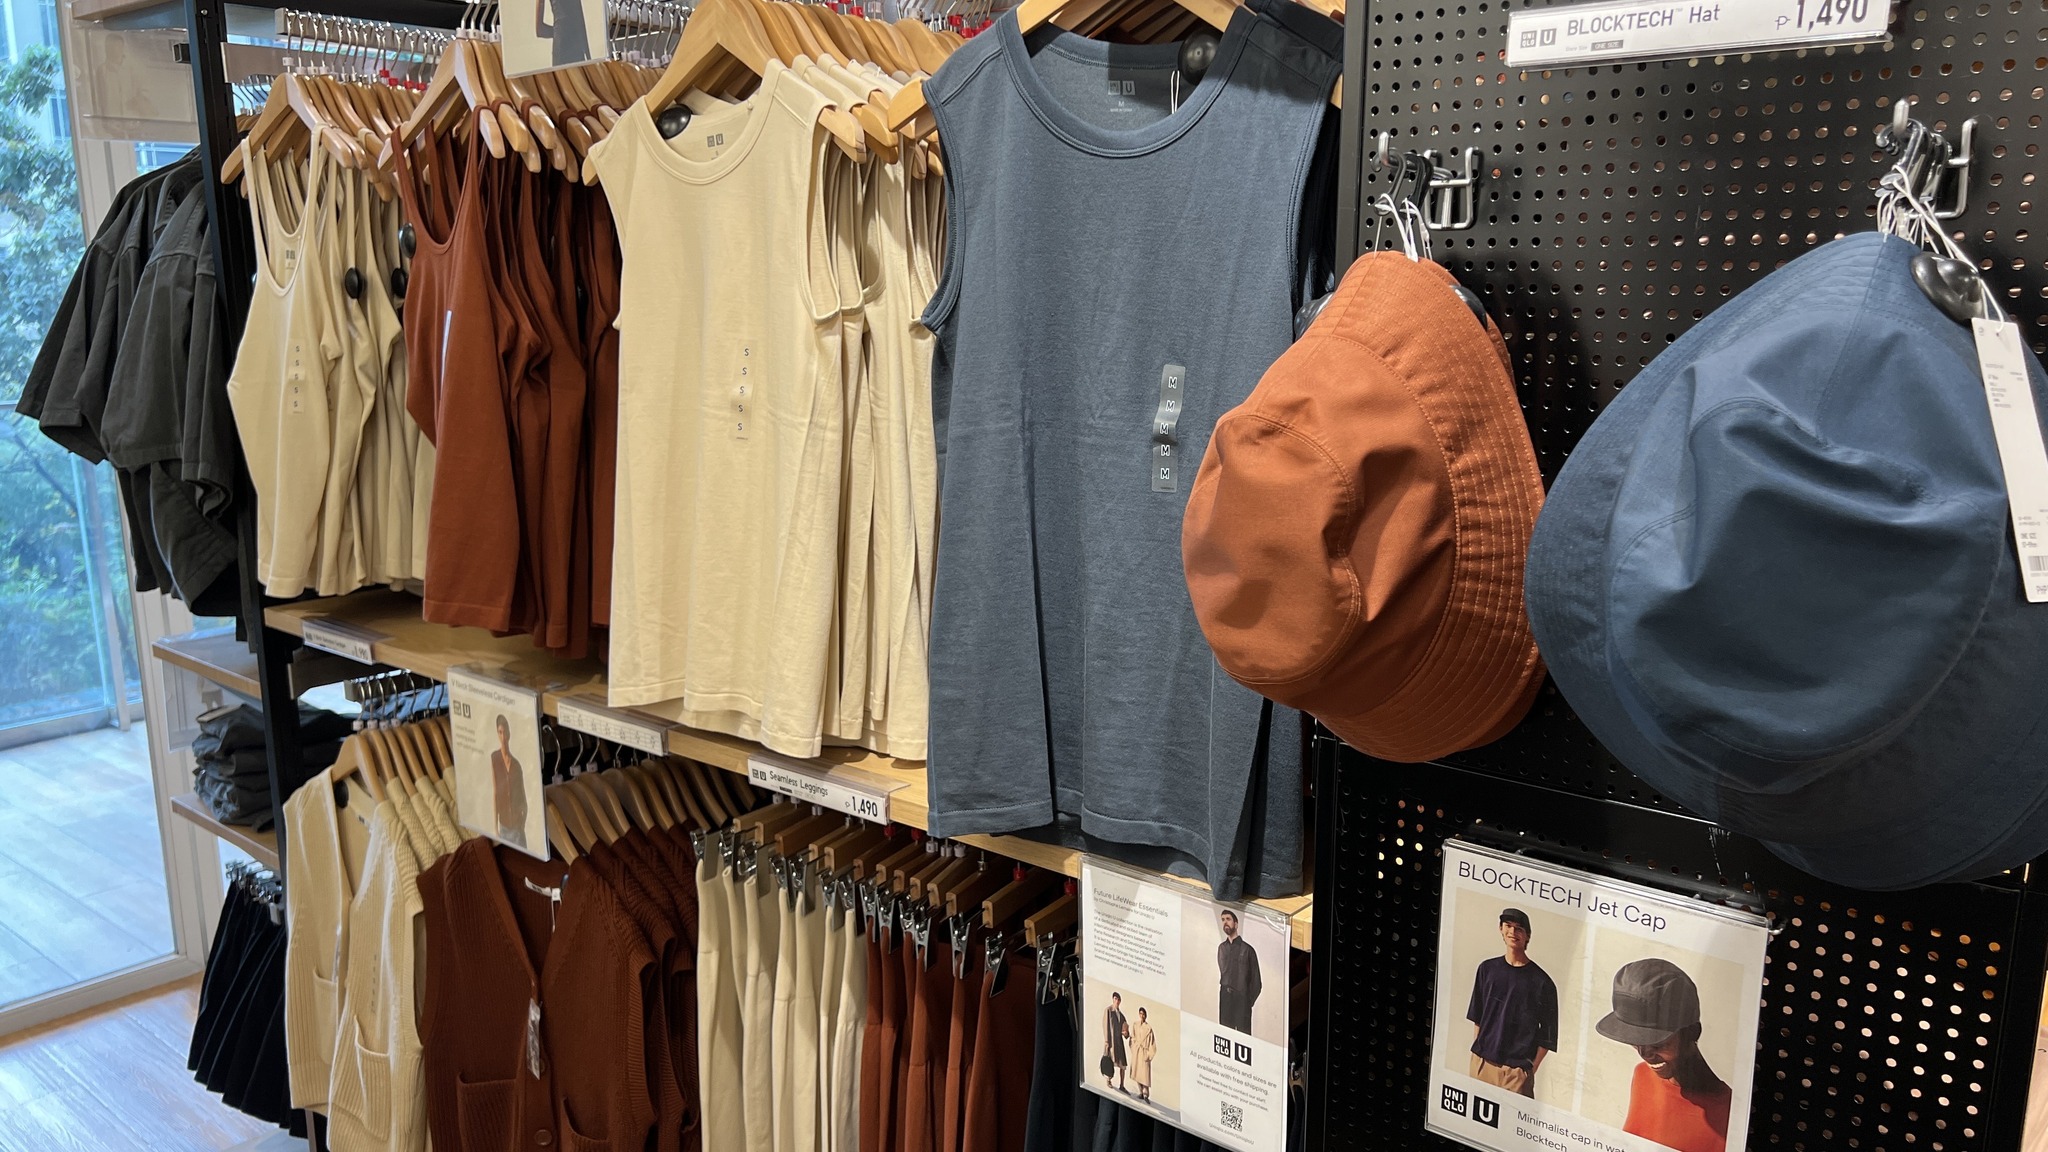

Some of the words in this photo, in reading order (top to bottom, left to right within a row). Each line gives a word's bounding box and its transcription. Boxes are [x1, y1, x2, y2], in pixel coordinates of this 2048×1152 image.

[1689, 4, 1720, 24] Hat
[1542, 30, 1553, 44] U
[744, 348, 749, 356] S
[742, 367, 747, 375] S
[1168, 376, 1177, 389] M
[740, 386, 744, 394] S
[738, 404, 743, 412] S
[1165, 400, 1175, 412] M
[738, 422, 742, 430] S
[1160, 422, 1169, 435] M
[1161, 444, 1170, 456] M
[1160, 468, 1169, 480] M
[769, 770, 798, 787] Seamless
[800, 780, 828, 797] Leggings
[1094, 887, 1112, 899] Future
[1139, 902, 1168, 918] Essentials
[1458, 861, 1582, 908] BLOCKTECH
[1587, 896, 1618, 918] Jet
[1624, 905, 1666, 932] Cap
[1215, 1045, 1229, 1055] QLO
[1216, 1037, 1229, 1046] UNI
[1238, 1045, 1248, 1062] U
[1241, 1070, 1252, 1079] and
[1443, 1100, 1464, 1113] QLO
[1444, 1088, 1463, 1101] UNI
[1478, 1100, 1494, 1122] U
[1517, 1111, 1569, 1137] Minimalist
[1571, 1132, 1591, 1145] cap
[1593, 1138, 1603, 1149] in
[1516, 1127, 1567, 1152] Blocktech
